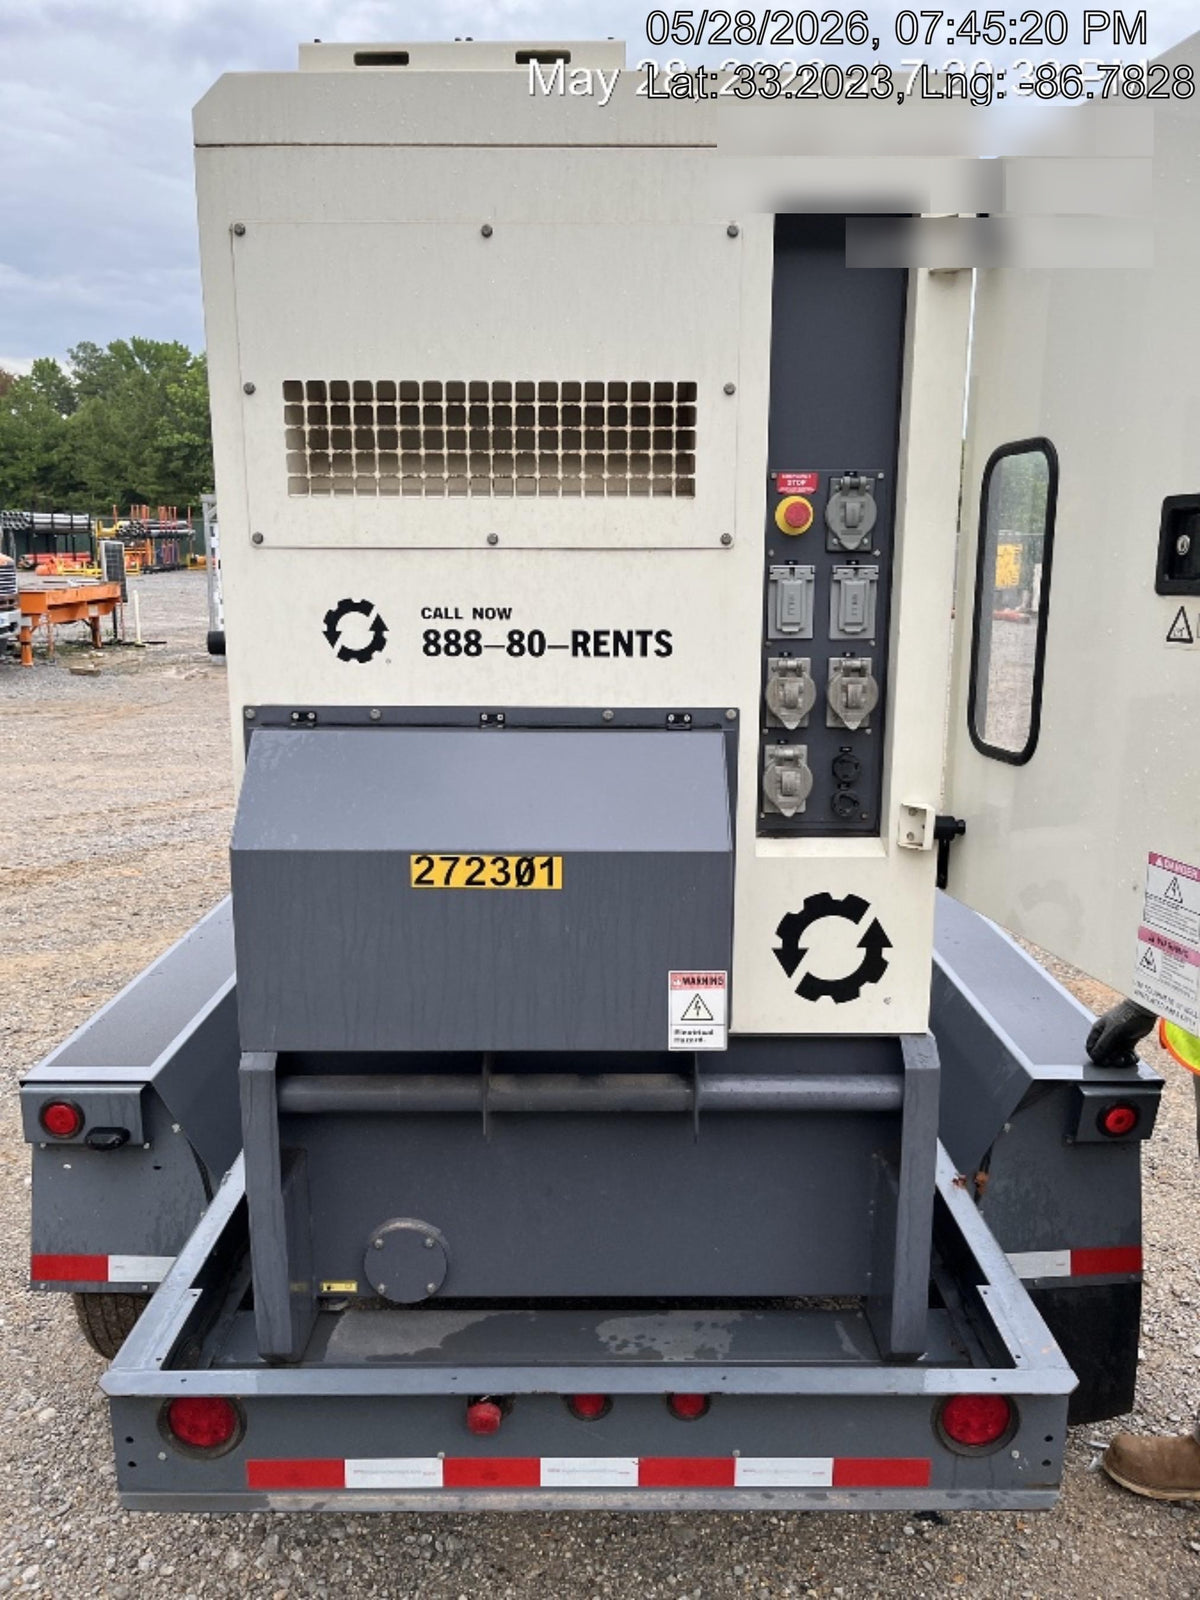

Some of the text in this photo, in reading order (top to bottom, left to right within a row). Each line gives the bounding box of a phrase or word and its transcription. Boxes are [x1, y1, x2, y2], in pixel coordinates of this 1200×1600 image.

[421, 607, 513, 620] CALL NOW
[414, 855, 554, 887] 272301
[682, 975, 725, 986] WARNING
